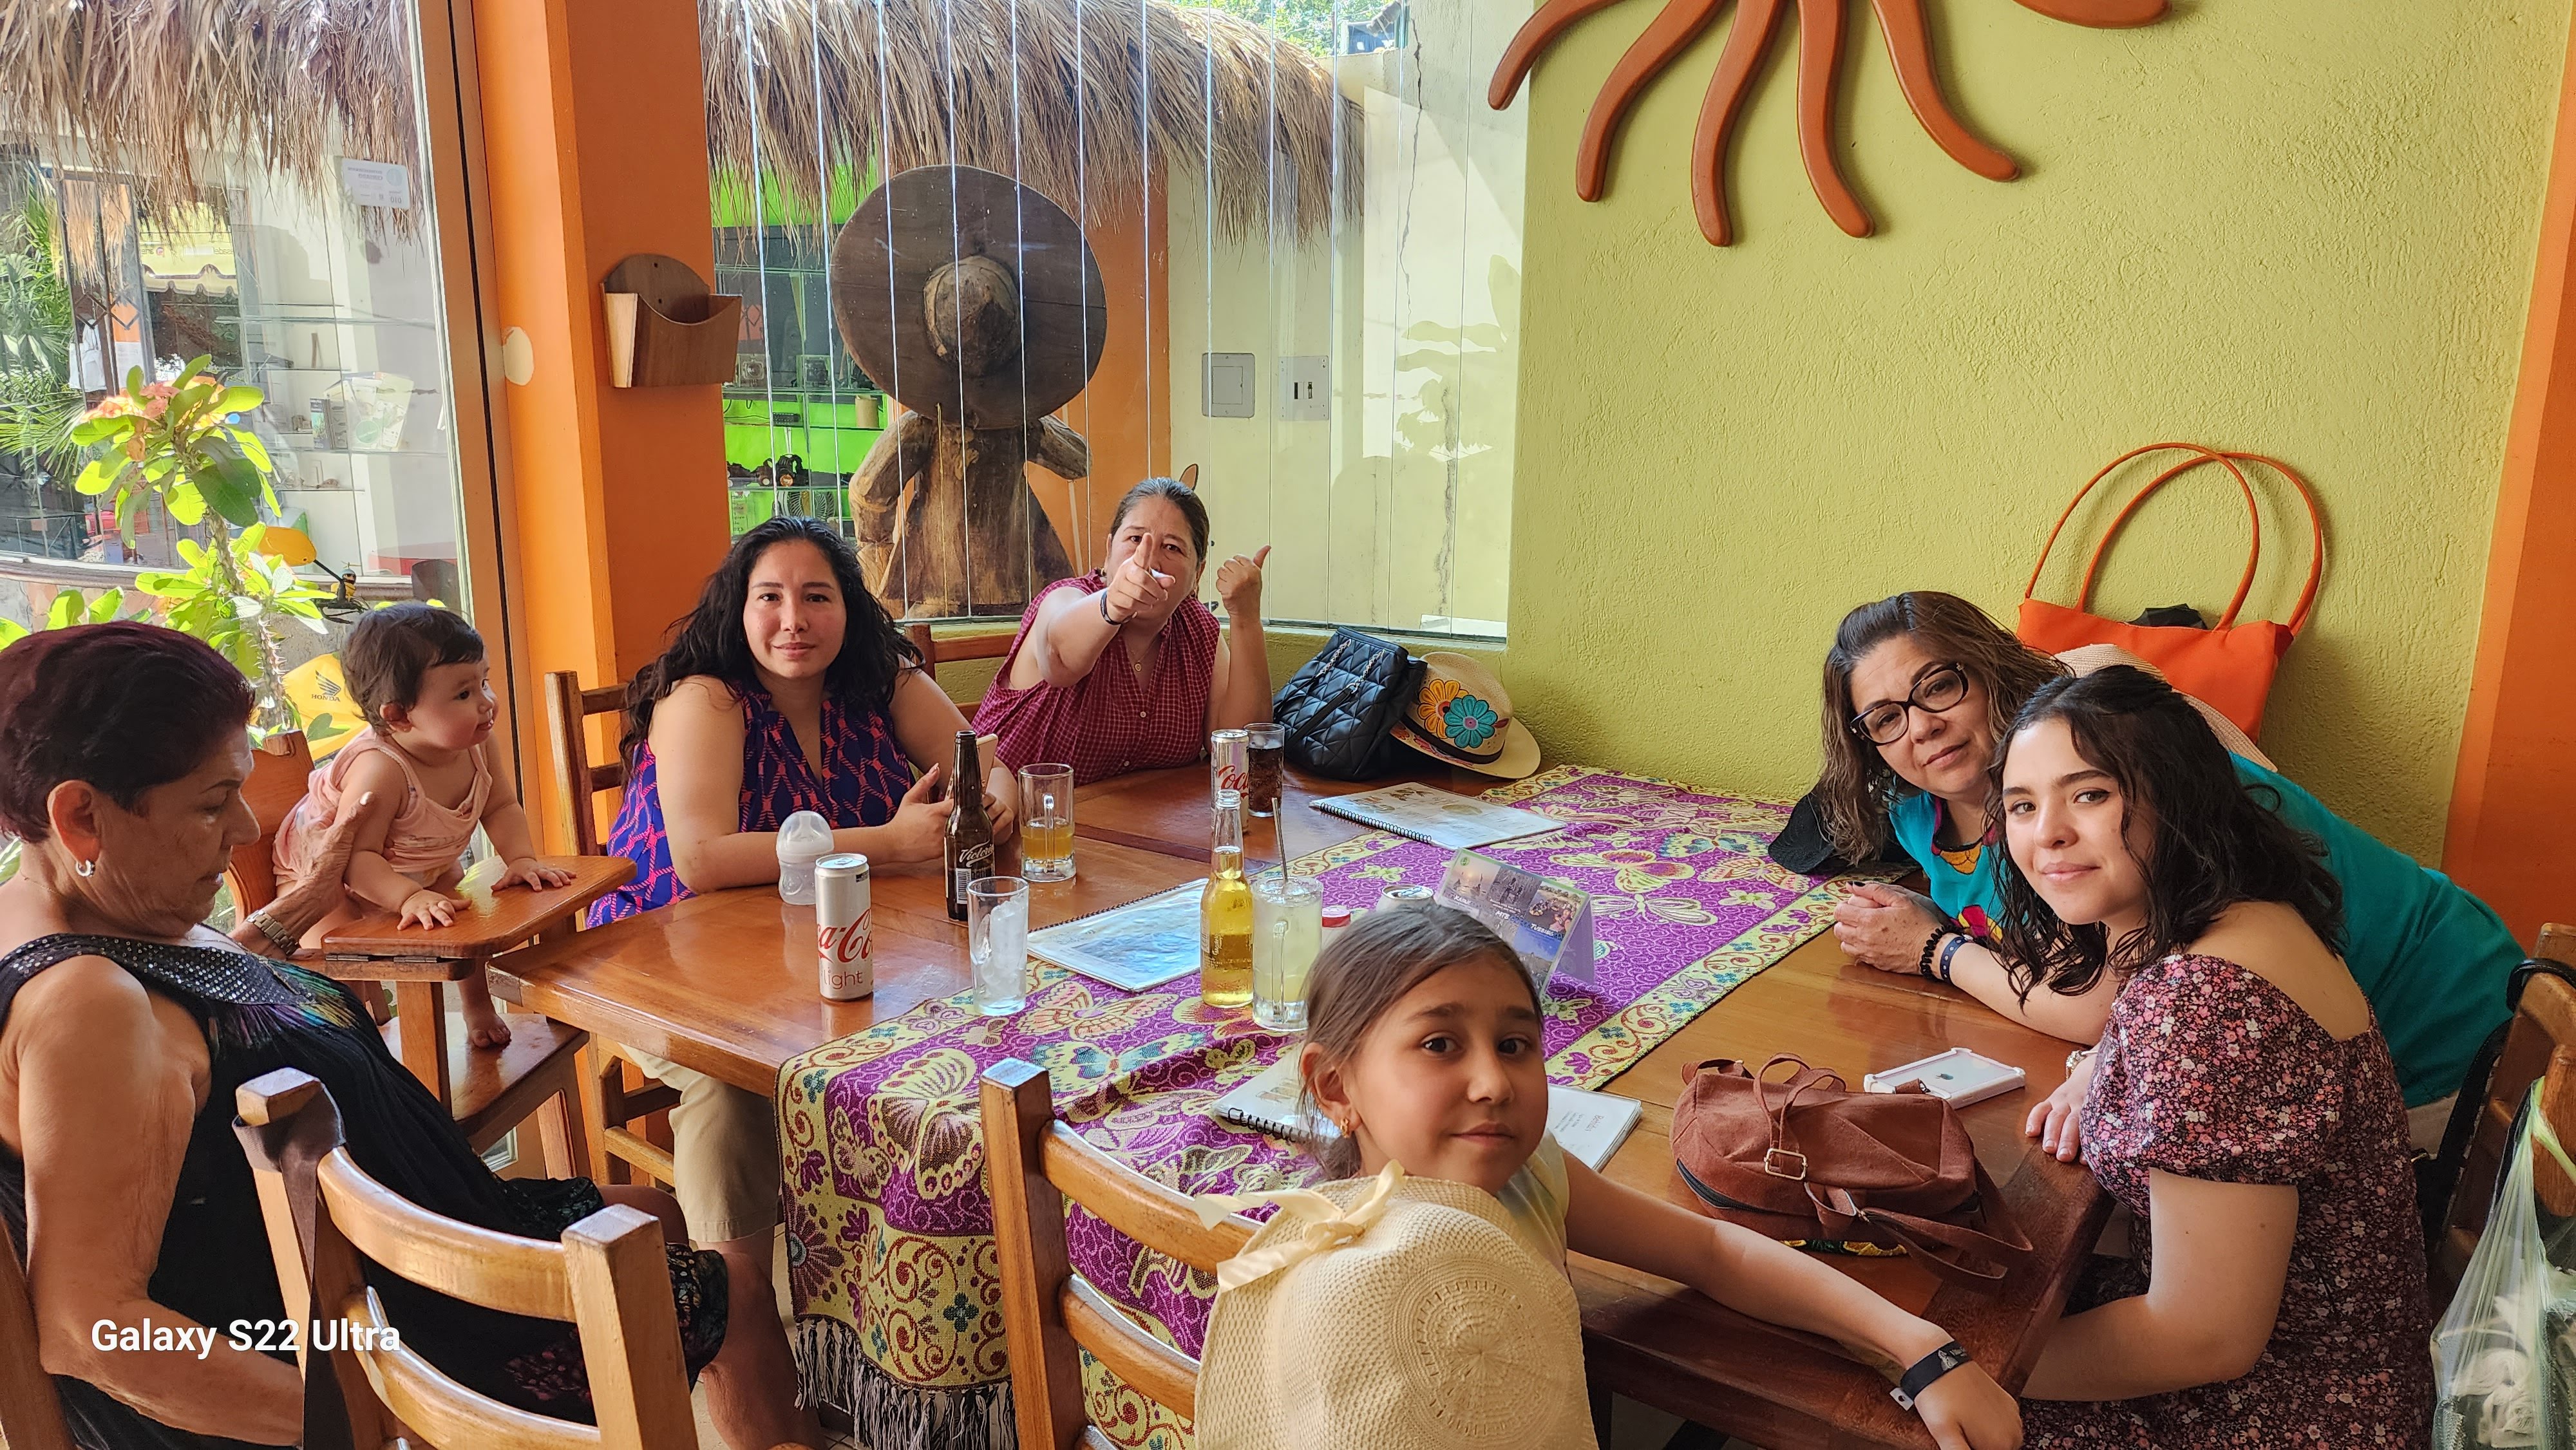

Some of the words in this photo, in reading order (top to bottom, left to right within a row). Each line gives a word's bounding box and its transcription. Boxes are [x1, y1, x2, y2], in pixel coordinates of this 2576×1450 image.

[311, 693, 341, 702] HONDA
[1495, 910, 1510, 920] MTB
[822, 967, 864, 990] light
